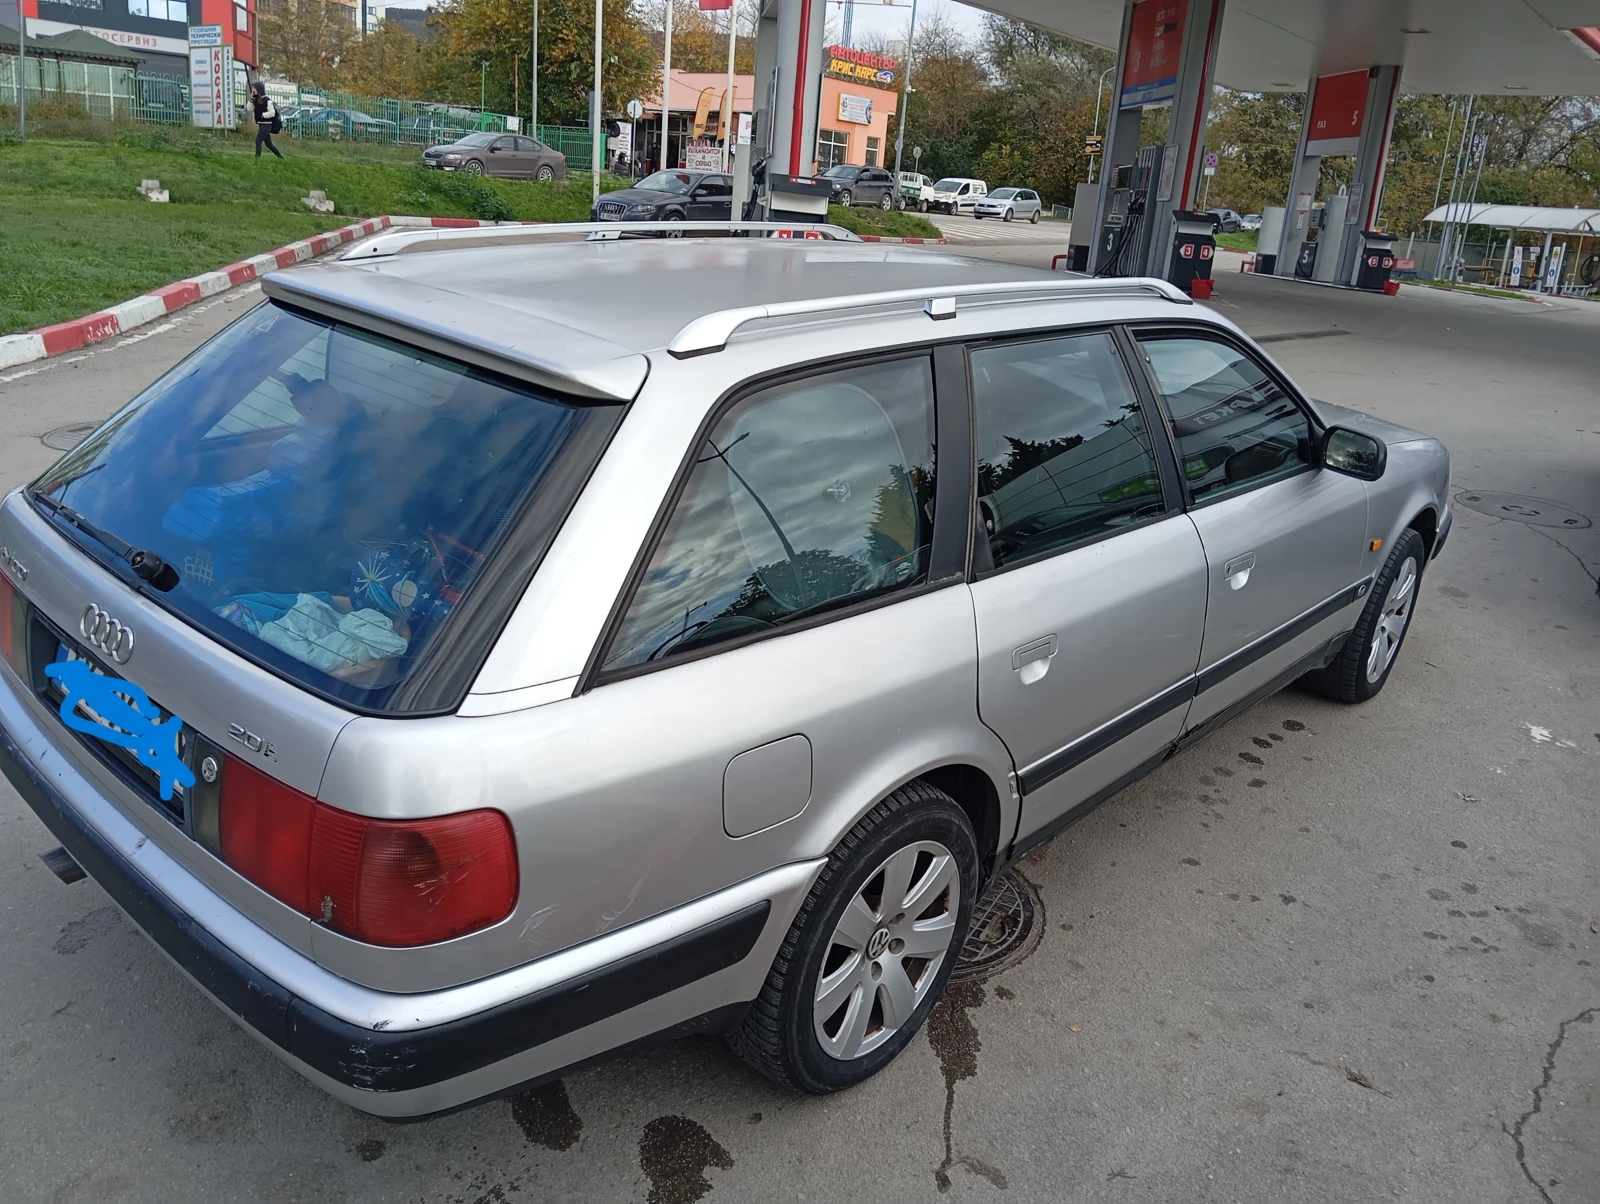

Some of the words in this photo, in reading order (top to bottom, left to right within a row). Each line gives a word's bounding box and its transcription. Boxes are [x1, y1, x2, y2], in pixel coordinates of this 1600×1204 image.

[829, 45, 897, 70] АВТОЦЕНТЪР
[1133, 50, 1141, 73] 3
[830, 59, 855, 75] КРИС
[855, 65, 878, 81] КАРС
[213, 50, 222, 125] КОСАРА
[1317, 120, 1327, 129] ГАЗ
[1351, 110, 1359, 126] 5
[1107, 233, 1114, 251] 3
[1185, 247, 1192, 255] 3
[1202, 248, 1209, 256] 4
[1302, 250, 1310, 264] 5
